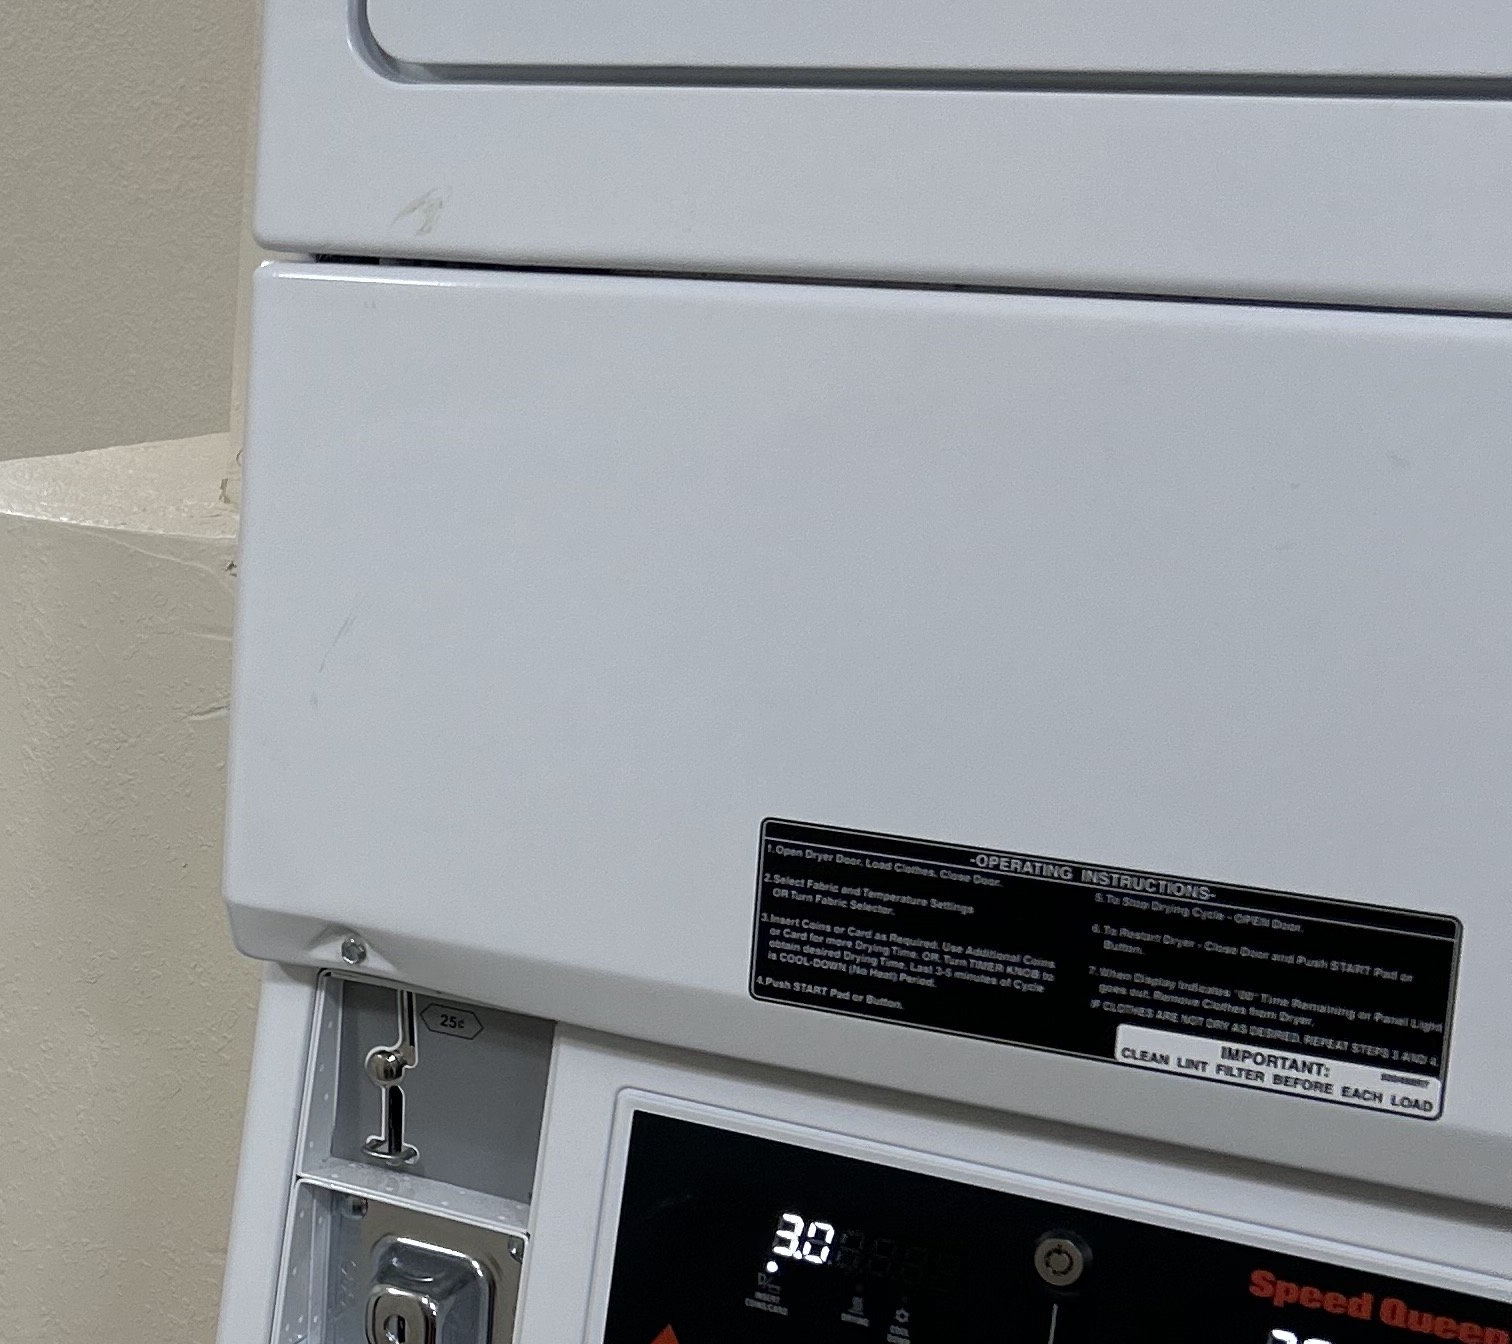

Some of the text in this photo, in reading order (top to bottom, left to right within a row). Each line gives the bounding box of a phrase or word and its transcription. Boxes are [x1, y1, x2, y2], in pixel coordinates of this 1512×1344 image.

[805, 849, 833, 862] Dryer
[865, 858, 893, 870] Load
[940, 870, 971, 883] Close
[806, 879, 839, 893] Fabric
[841, 886, 861, 896] and
[863, 888, 928, 907] Temperature
[930, 898, 975, 915] Settings
[815, 894, 847, 908] Fabric
[769, 928, 780, 936] or
[783, 929, 807, 940] Card
[809, 933, 824, 943] for
[826, 937, 852, 948] more
[855, 940, 889, 956] Drying
[801, 919, 831, 932] Coins
[833, 926, 846, 934] or
[847, 926, 873, 938] Card
[874, 933, 887, 941] as
[942, 942, 964, 953] Use
[768, 939, 801, 952] obtain
[803, 944, 841, 958] desired
[843, 950, 878, 966] Drying
[909, 962, 933, 973] Last
[953, 971, 998, 985] minutes
[999, 977, 1012, 987] of
[1013, 979, 1044, 993] Cycle
[779, 952, 847, 972] COOL-DOWN
[793, 981, 828, 996] START
[830, 988, 850, 1000] Pad
[852, 994, 864, 1002] or
[1220, 1046, 1330, 1077] IMPORTANT:
[1121, 1047, 1433, 1113] CLEAN LINT FILTER BEFORE EACH LOAD
[1249, 1269, 1375, 1321] Speed
